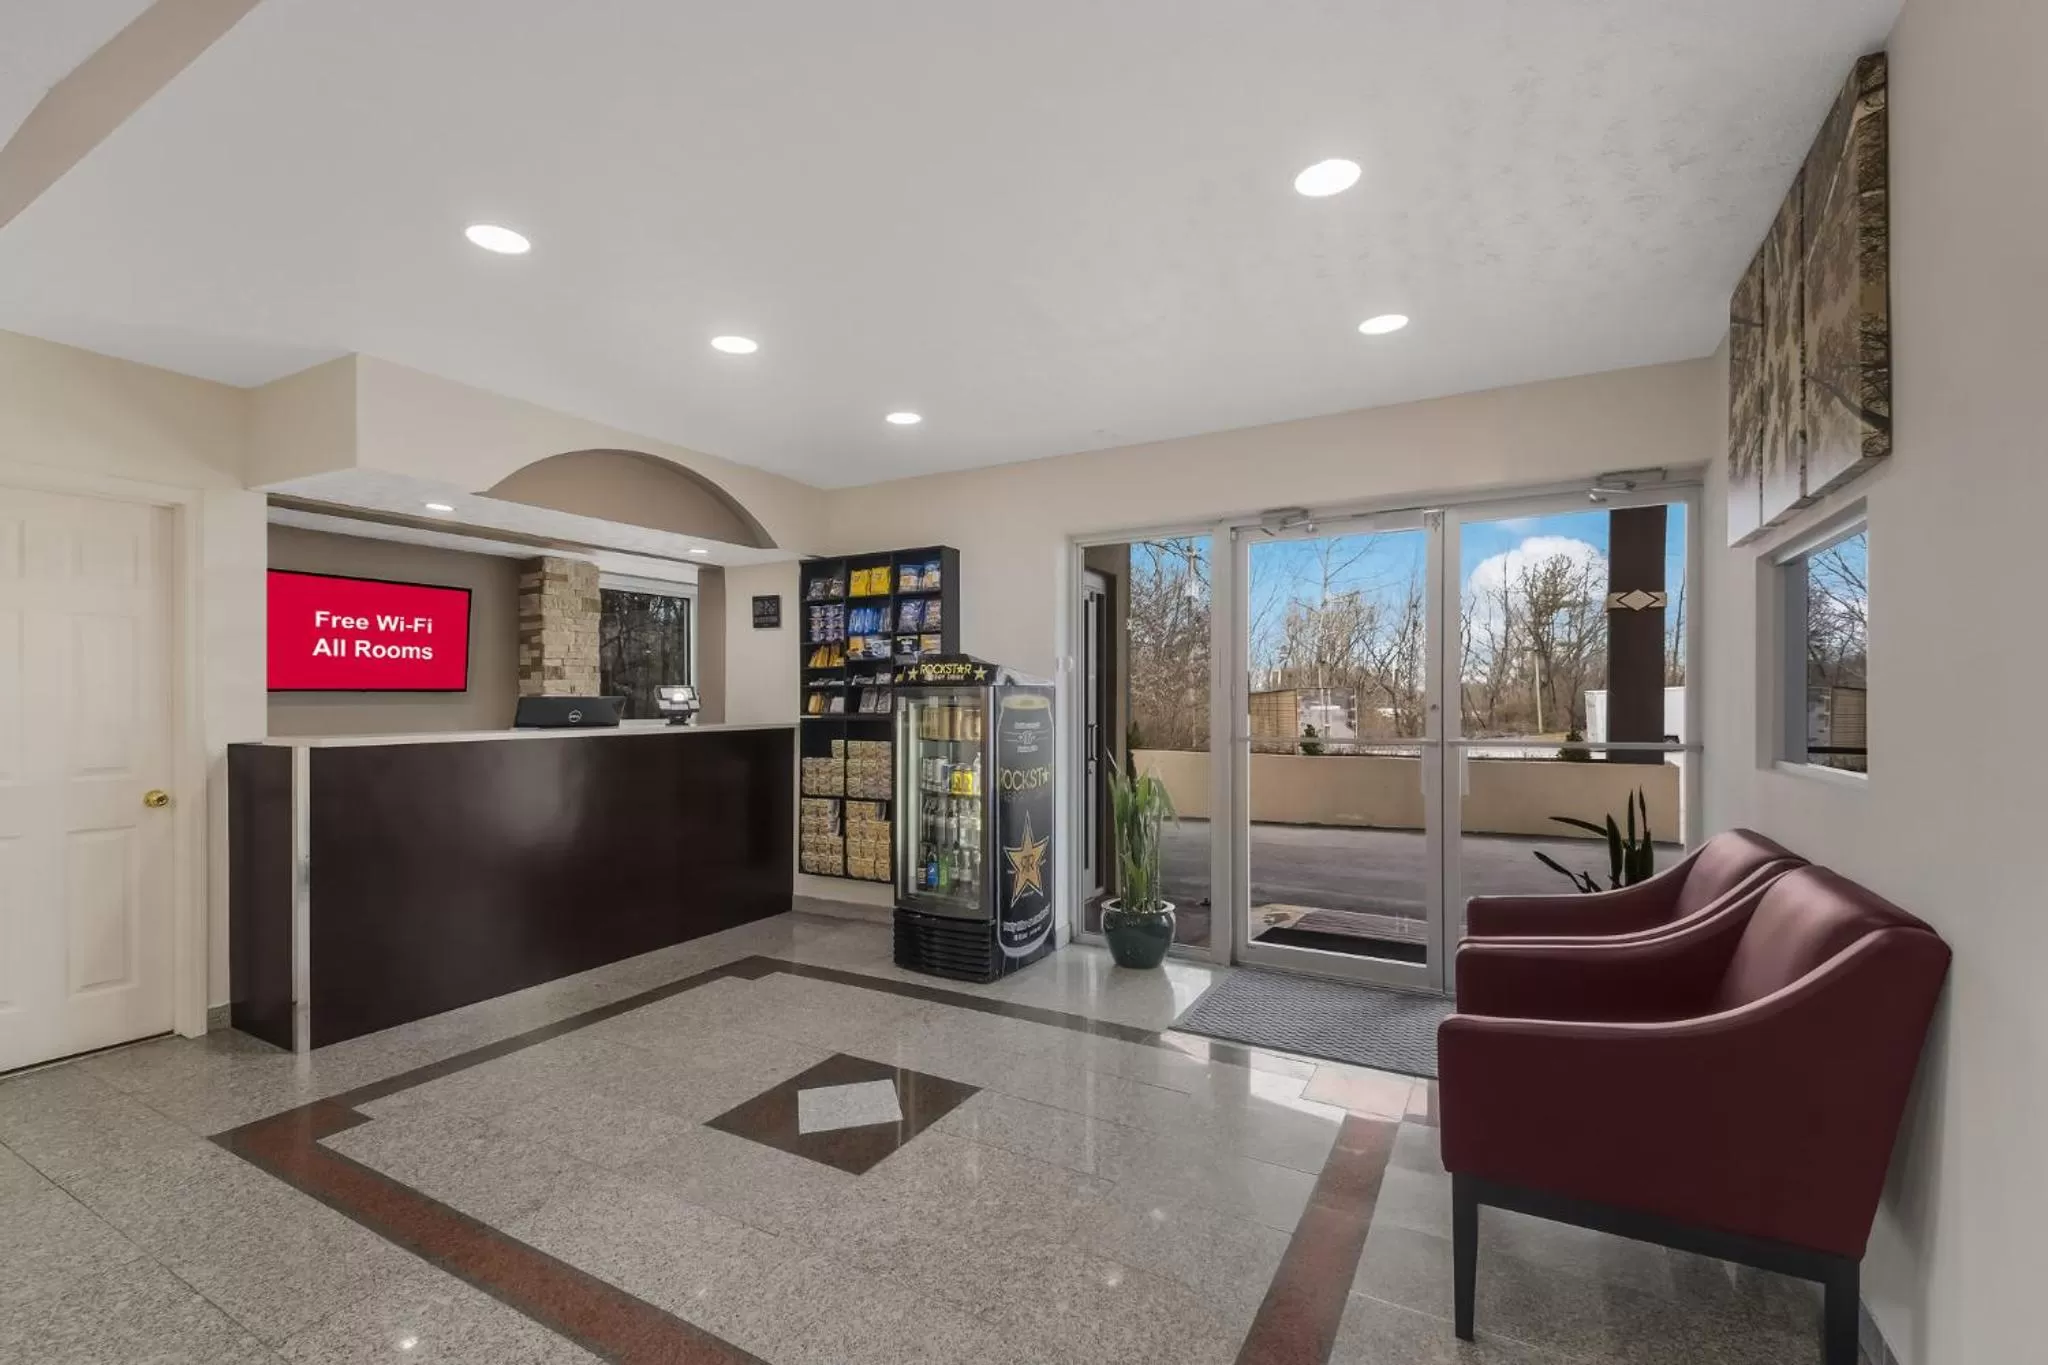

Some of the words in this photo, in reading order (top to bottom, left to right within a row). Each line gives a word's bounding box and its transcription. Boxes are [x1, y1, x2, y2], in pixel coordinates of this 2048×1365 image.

[314, 611, 369, 630] Free
[376, 614, 432, 634] Wi-Fi
[312, 638, 346, 657] All
[355, 640, 433, 660] Rooms
